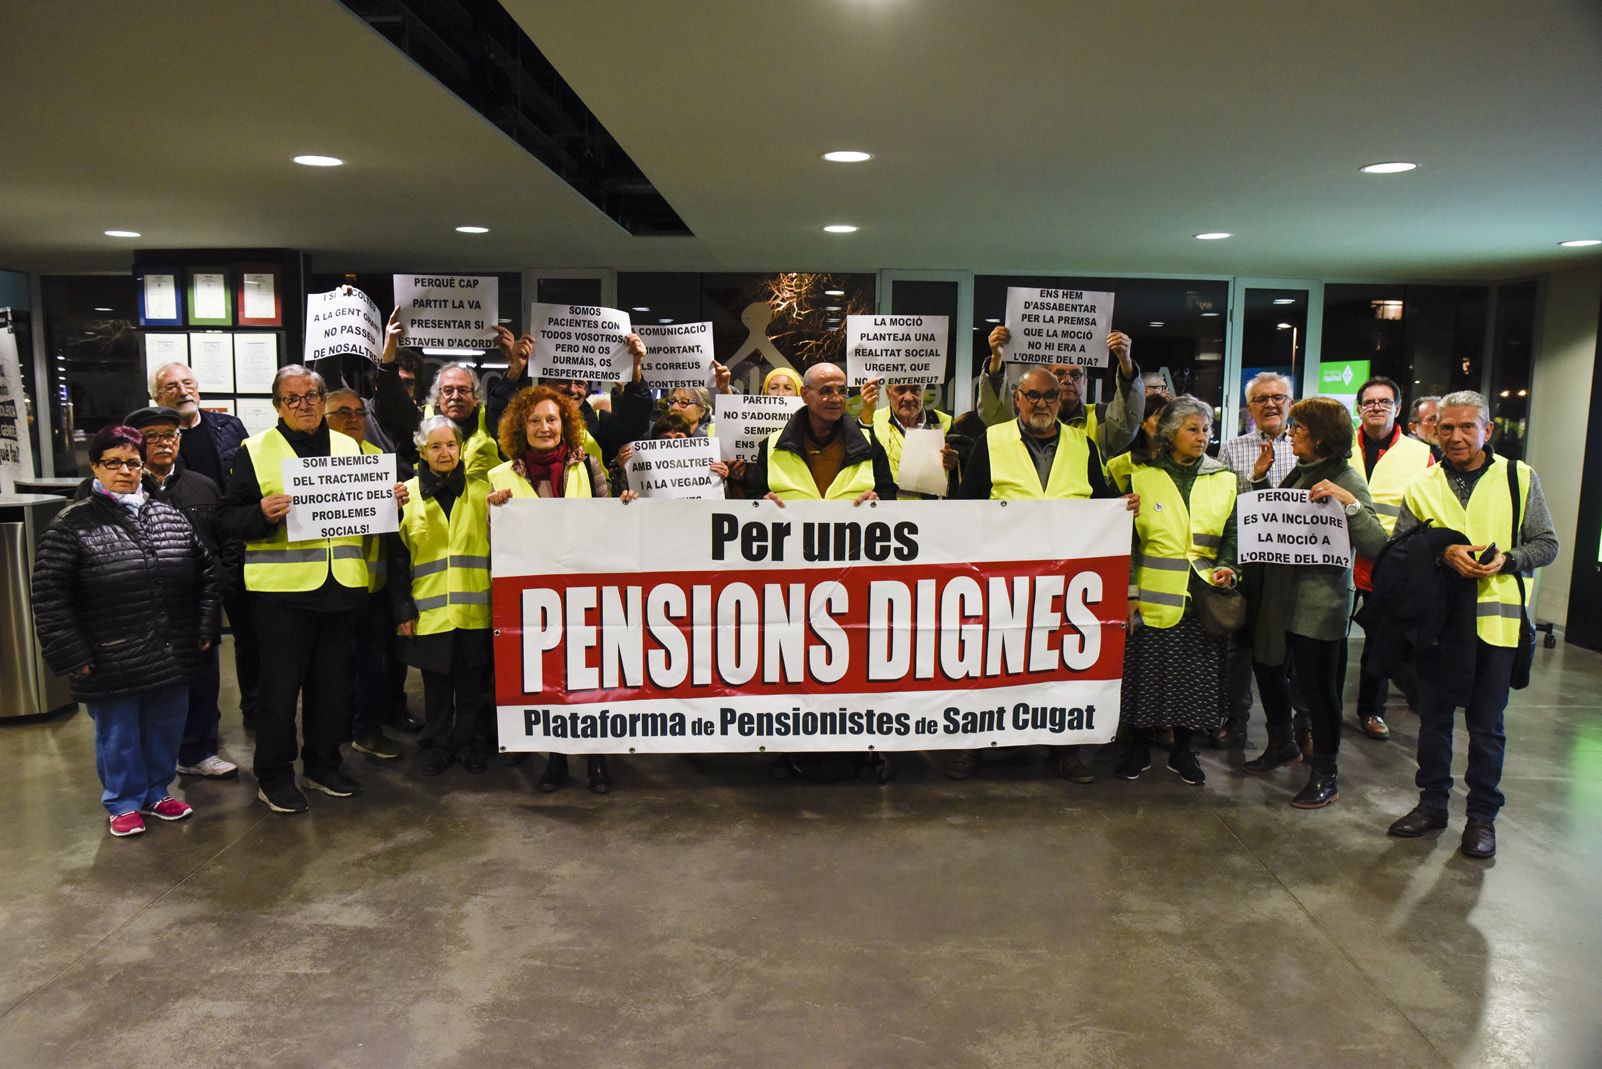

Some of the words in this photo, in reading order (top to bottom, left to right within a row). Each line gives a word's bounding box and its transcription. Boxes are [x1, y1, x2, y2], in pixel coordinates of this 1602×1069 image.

[414, 277, 456, 288] PERQUÈ
[458, 279, 479, 288] CAP
[1040, 290, 1059, 298] ENS
[1062, 291, 1083, 300] HEM
[412, 299, 448, 308] PARTIT
[452, 300, 465, 309] LA
[468, 300, 481, 310] VA
[1024, 302, 1096, 314] D'ASSABENTAR
[323, 312, 332, 320] LA
[335, 308, 362, 317] GENT
[569, 306, 601, 316] SOMOS
[410, 320, 471, 329] PRESENTAR
[474, 320, 484, 330] SI
[548, 318, 598, 328] PACIENTES
[602, 322, 620, 330] CON
[874, 318, 886, 326] LA
[890, 316, 922, 326] MOCIÓ
[1021, 314, 1040, 322] PER
[1042, 316, 1054, 324] LA
[1058, 316, 1097, 326] PREMSA
[324, 327, 338, 338] NO
[341, 326, 376, 345] PASSEU
[638, 323, 706, 336] COMUNICACIÓ
[1024, 328, 1044, 337] QUE
[1046, 330, 1058, 338] LA
[1061, 330, 1093, 340] MOCIÓ
[398, 337, 444, 346] ESTAVEN
[541, 330, 572, 340] TODOS
[575, 332, 626, 344] VOSOTROS,
[860, 333, 911, 341] PLANTEJA
[314, 348, 326, 358] DE
[556, 344, 580, 352] PERO
[582, 346, 596, 354] NO
[598, 346, 610, 354] OS
[646, 345, 702, 354] IMPORTANT,
[904, 349, 940, 357] SOCIAL
[1028, 342, 1042, 350] NO
[1058, 343, 1076, 352] ERA
[1079, 344, 1086, 352] A
[553, 356, 596, 368] DURMÁIS,
[600, 358, 612, 367] OS
[1014, 353, 1054, 363] L'ORDRE
[1056, 356, 1074, 364] DEL
[1077, 356, 1098, 366] DIA?
[656, 362, 700, 370] CORREUS
[865, 363, 906, 372] URGENT,
[910, 363, 930, 372] QUE
[542, 368, 620, 380] DESPERTAREMOS
[888, 376, 938, 384] ENTENEU?
[648, 380, 704, 388] CONTESTEN
[743, 396, 788, 406] PARTITS,
[724, 411, 738, 420] NO
[744, 427, 784, 435] SEMPR
[634, 440, 656, 452] SOM
[660, 438, 710, 450] PACIENTS
[735, 441, 755, 449] ENS
[303, 458, 328, 468] SOM
[331, 456, 379, 466] ENEMICS
[632, 461, 652, 472] AMB
[655, 458, 714, 470] VOSALTRES
[293, 476, 315, 486] DEL
[318, 472, 390, 484] TRACTAMENT
[641, 481, 644, 490] I
[646, 482, 652, 490] A
[655, 480, 668, 489] LA
[670, 476, 712, 488] VEGADA
[293, 490, 364, 505] BUROCRÀTIC
[367, 490, 392, 500] DELS
[1258, 491, 1306, 503] PERQUÈ
[312, 507, 376, 520] PROBLEMES
[1244, 514, 1258, 525] ES
[1262, 513, 1278, 522] VA
[1282, 514, 1343, 528] INCLOURE
[321, 525, 370, 538] SOCIALS!
[712, 513, 791, 562] Per
[802, 520, 918, 562] unes
[1258, 533, 1274, 542] LA
[1278, 533, 1318, 545] MOCIÓ
[1322, 536, 1330, 545] A
[1241, 552, 1290, 562] L'ORDRE
[1294, 554, 1318, 563] DEL
[1322, 554, 1349, 566] DIA?
[522, 580, 850, 693] PENSIONS
[867, 571, 1104, 682] DIGNES
[524, 709, 686, 738] Plataforma
[692, 718, 714, 736] de
[720, 707, 910, 736] Pensionistes
[915, 717, 938, 734] de
[944, 706, 1006, 735] Sant
[1012, 702, 1096, 732] Cugat
